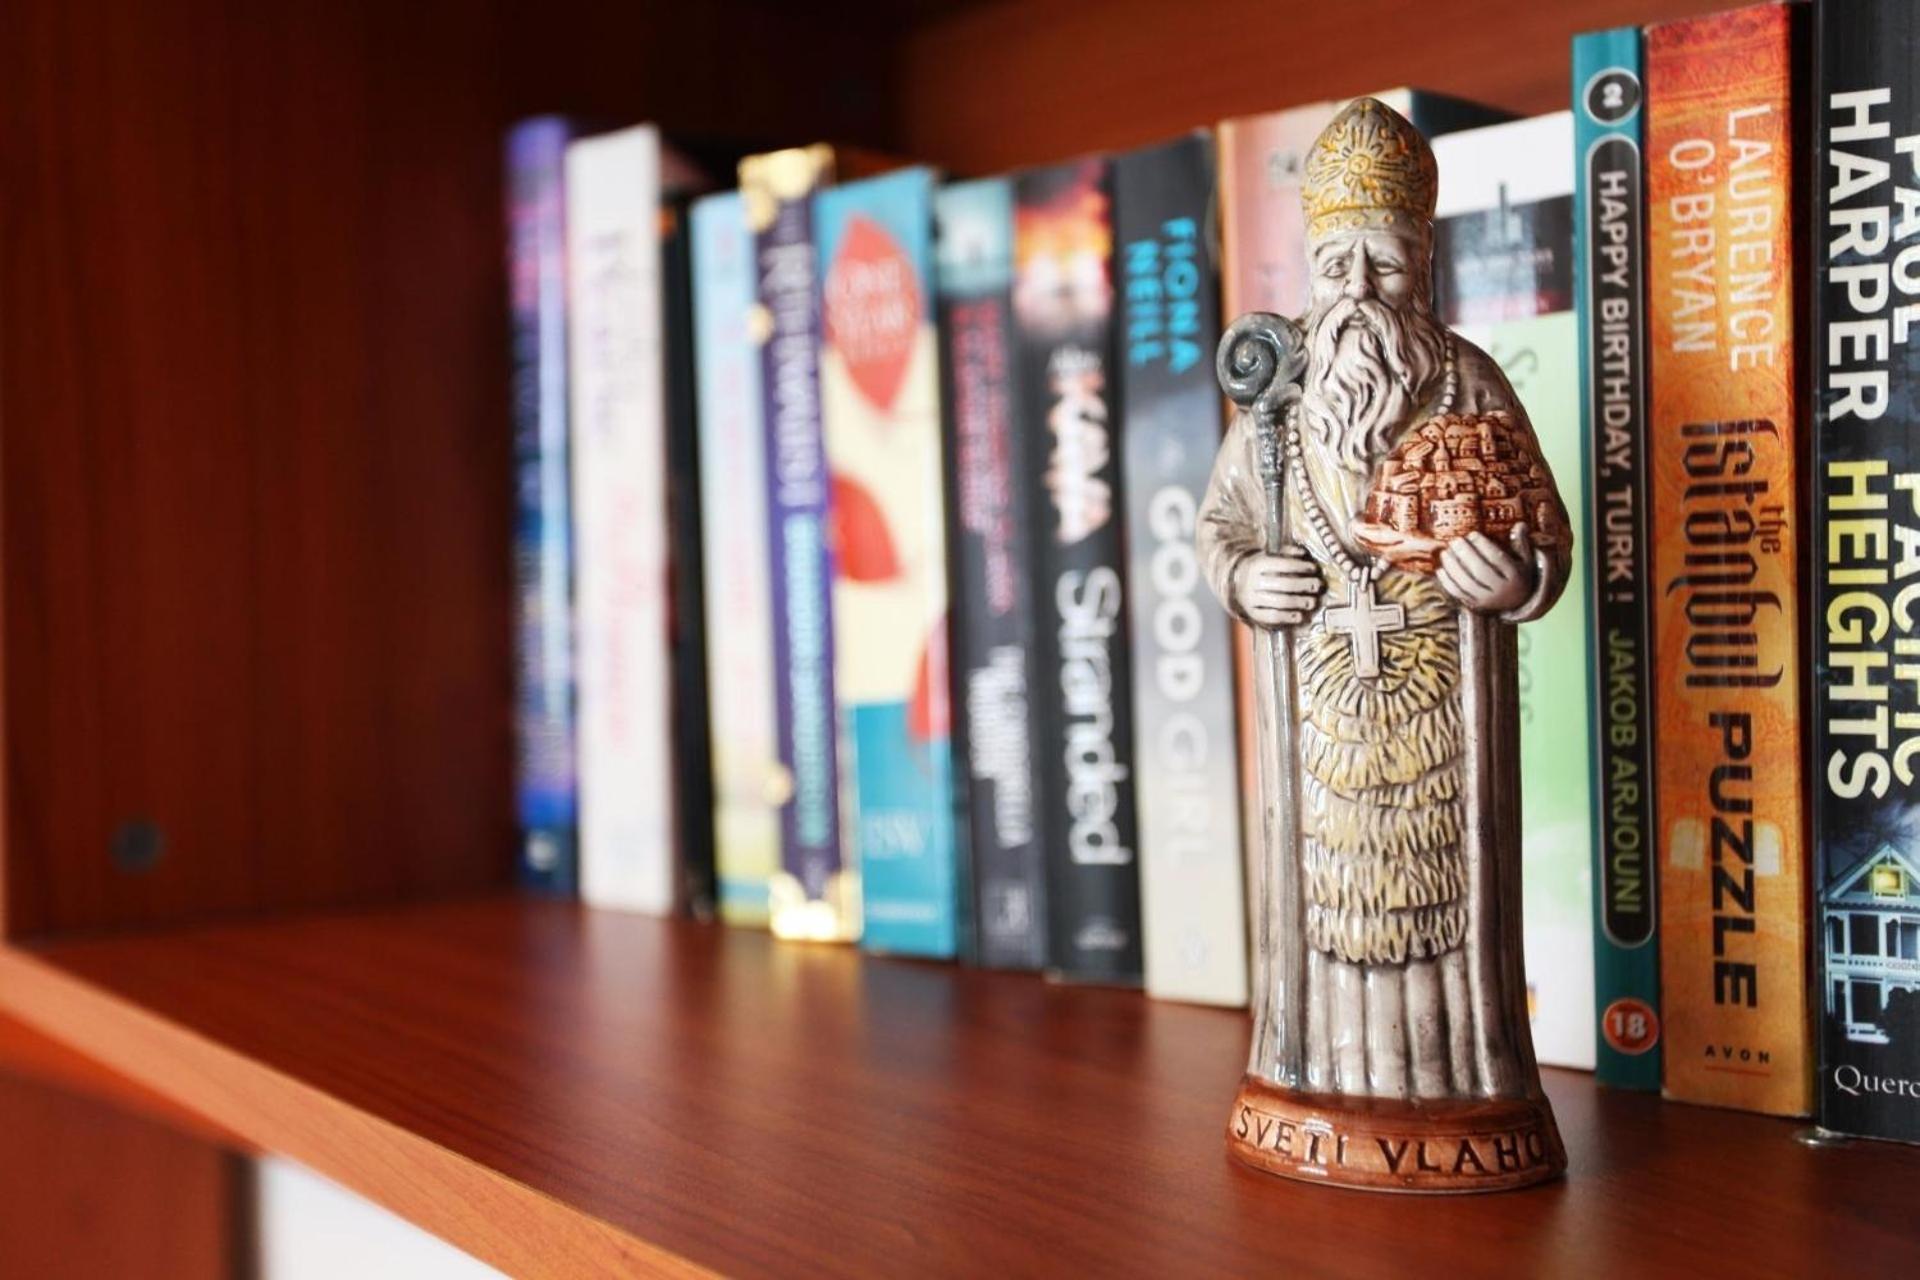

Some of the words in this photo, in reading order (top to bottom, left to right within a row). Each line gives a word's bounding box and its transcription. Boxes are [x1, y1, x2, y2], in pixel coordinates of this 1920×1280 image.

[1125, 239, 1164, 369] NEILL
[1161, 216, 1201, 374] FIONA
[1598, 170, 1629, 290] HAPPY
[1669, 137, 1715, 355] O'BRYAN
[1727, 104, 1774, 373] LAURENCE
[1829, 87, 1891, 422] HARPER
[1601, 298, 1633, 477] BIRTHDAY,
[1149, 484, 1205, 701] GOOD
[1605, 485, 1634, 583] TURK
[1667, 417, 1783, 689] Istanbul
[1755, 505, 1788, 554] the
[1608, 628, 1637, 746] JAKOB
[1827, 460, 1890, 799] HEIGHTS
[1056, 565, 1133, 865] Stranded
[1157, 711, 1210, 868] GIRL
[1609, 756, 1641, 914] ARJOUNI
[1708, 711, 1758, 1009] PUZZLE
[1610, 1010, 1647, 1040] 18
[1704, 1044, 1770, 1064] AVON
[1236, 1105, 1348, 1167] SVETI
[1376, 1129, 1547, 1175] VLAHO
